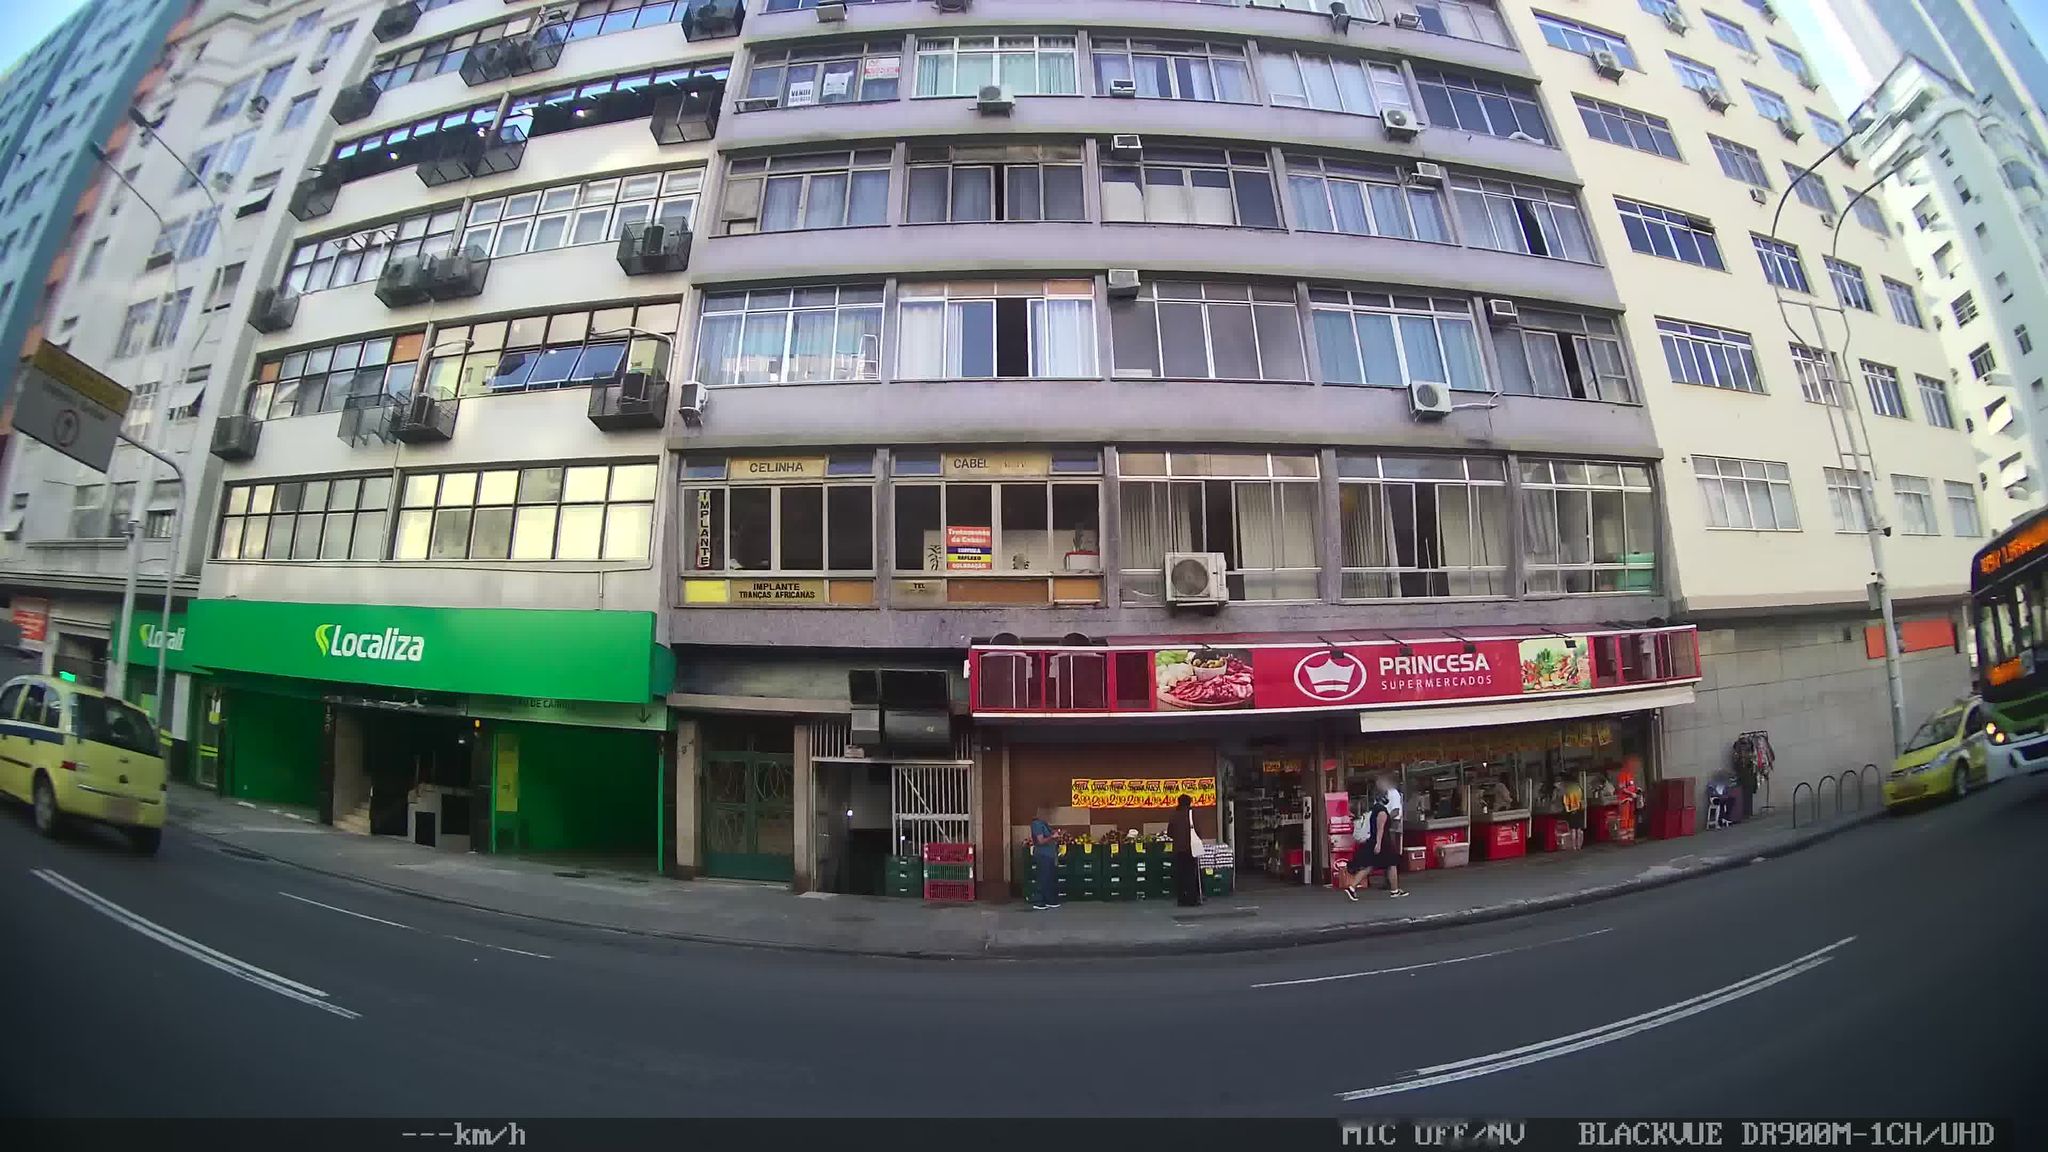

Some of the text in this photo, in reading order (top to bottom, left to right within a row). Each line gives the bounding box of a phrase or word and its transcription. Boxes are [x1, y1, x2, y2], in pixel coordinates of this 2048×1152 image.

[750, 461, 804, 473] CELINHA
[700, 491, 709, 565] IMPLANTE
[753, 583, 800, 591] IMPLANTE
[739, 591, 816, 599] TRANÇAS AFRICANAS
[330, 624, 425, 661] Localiza
[1379, 653, 1490, 676] PRINCESA
[1381, 675, 1492, 690] SUPERMERCADOS
